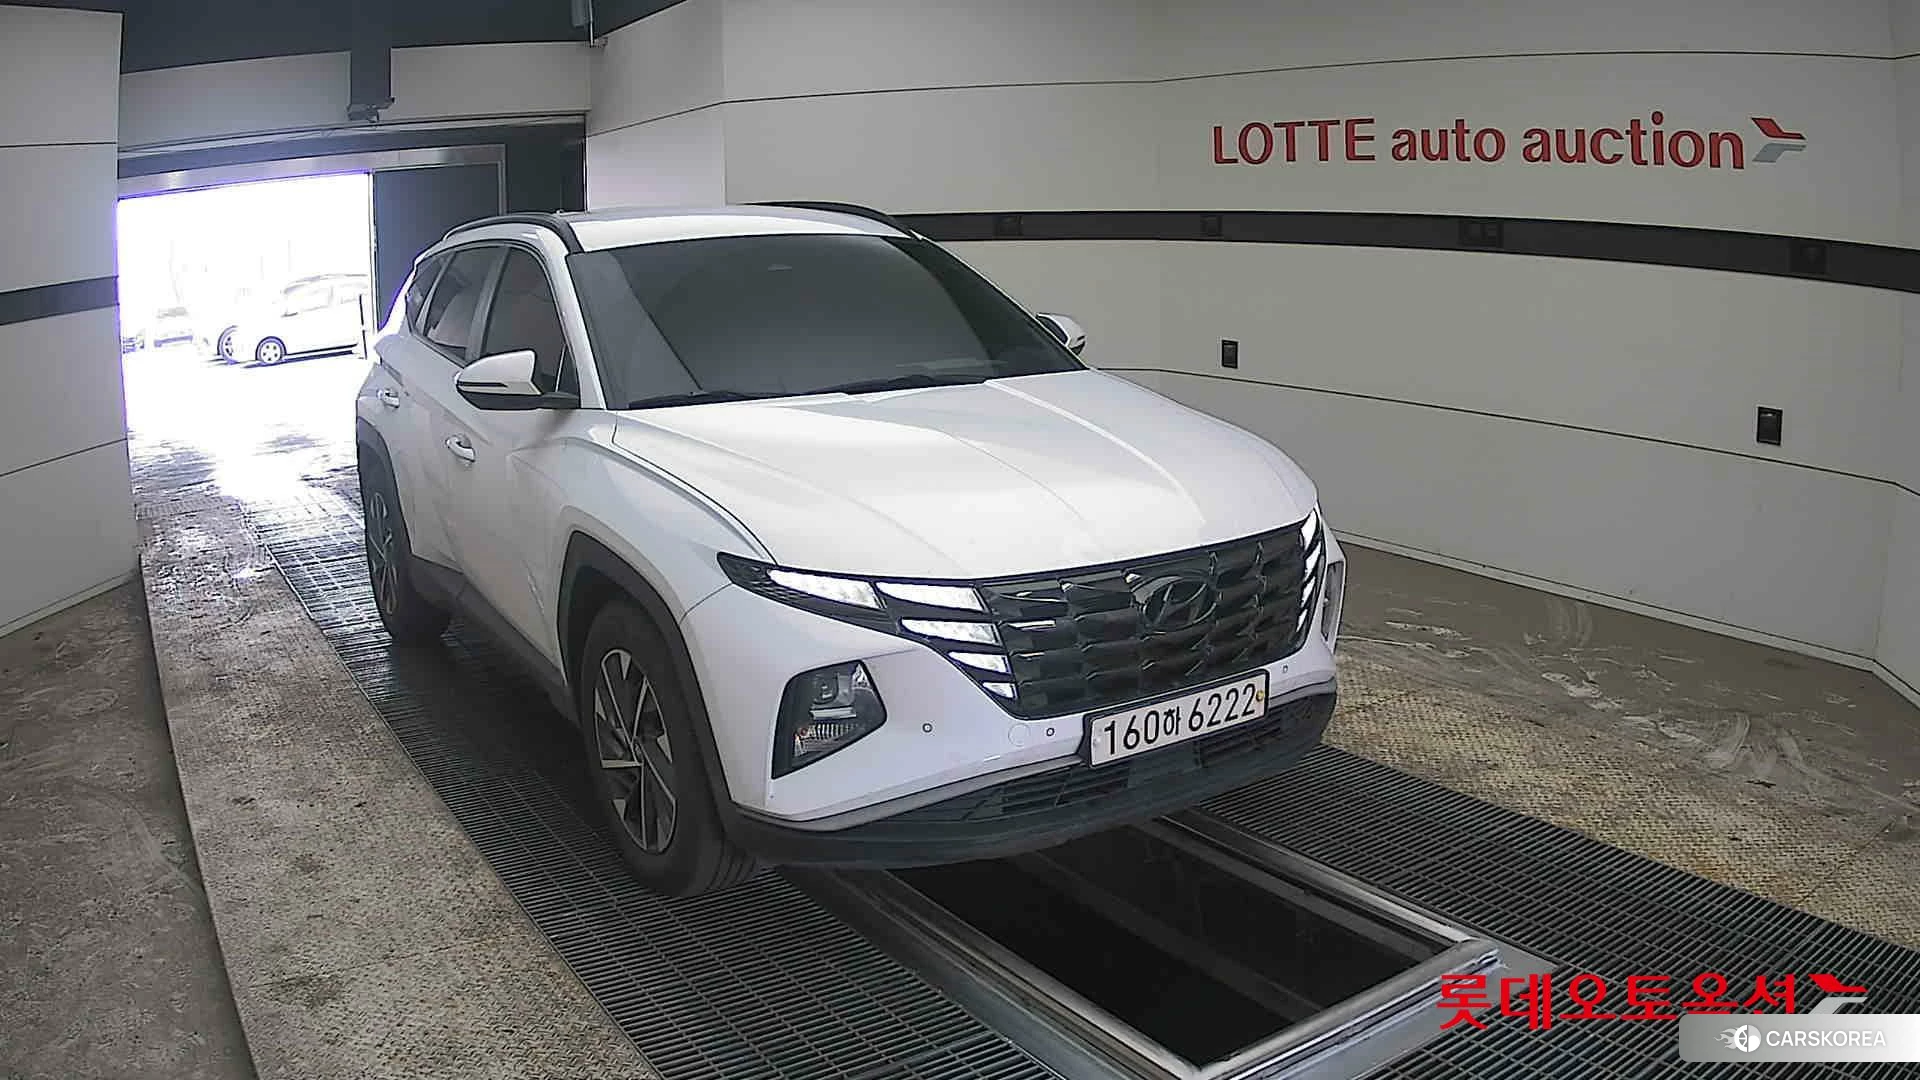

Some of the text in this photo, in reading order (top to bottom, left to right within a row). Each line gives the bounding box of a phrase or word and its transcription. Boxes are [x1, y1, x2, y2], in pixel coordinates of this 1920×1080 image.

[1212, 111, 1745, 169] LOTTE auto auction
[1188, 683, 1256, 732] 6222
